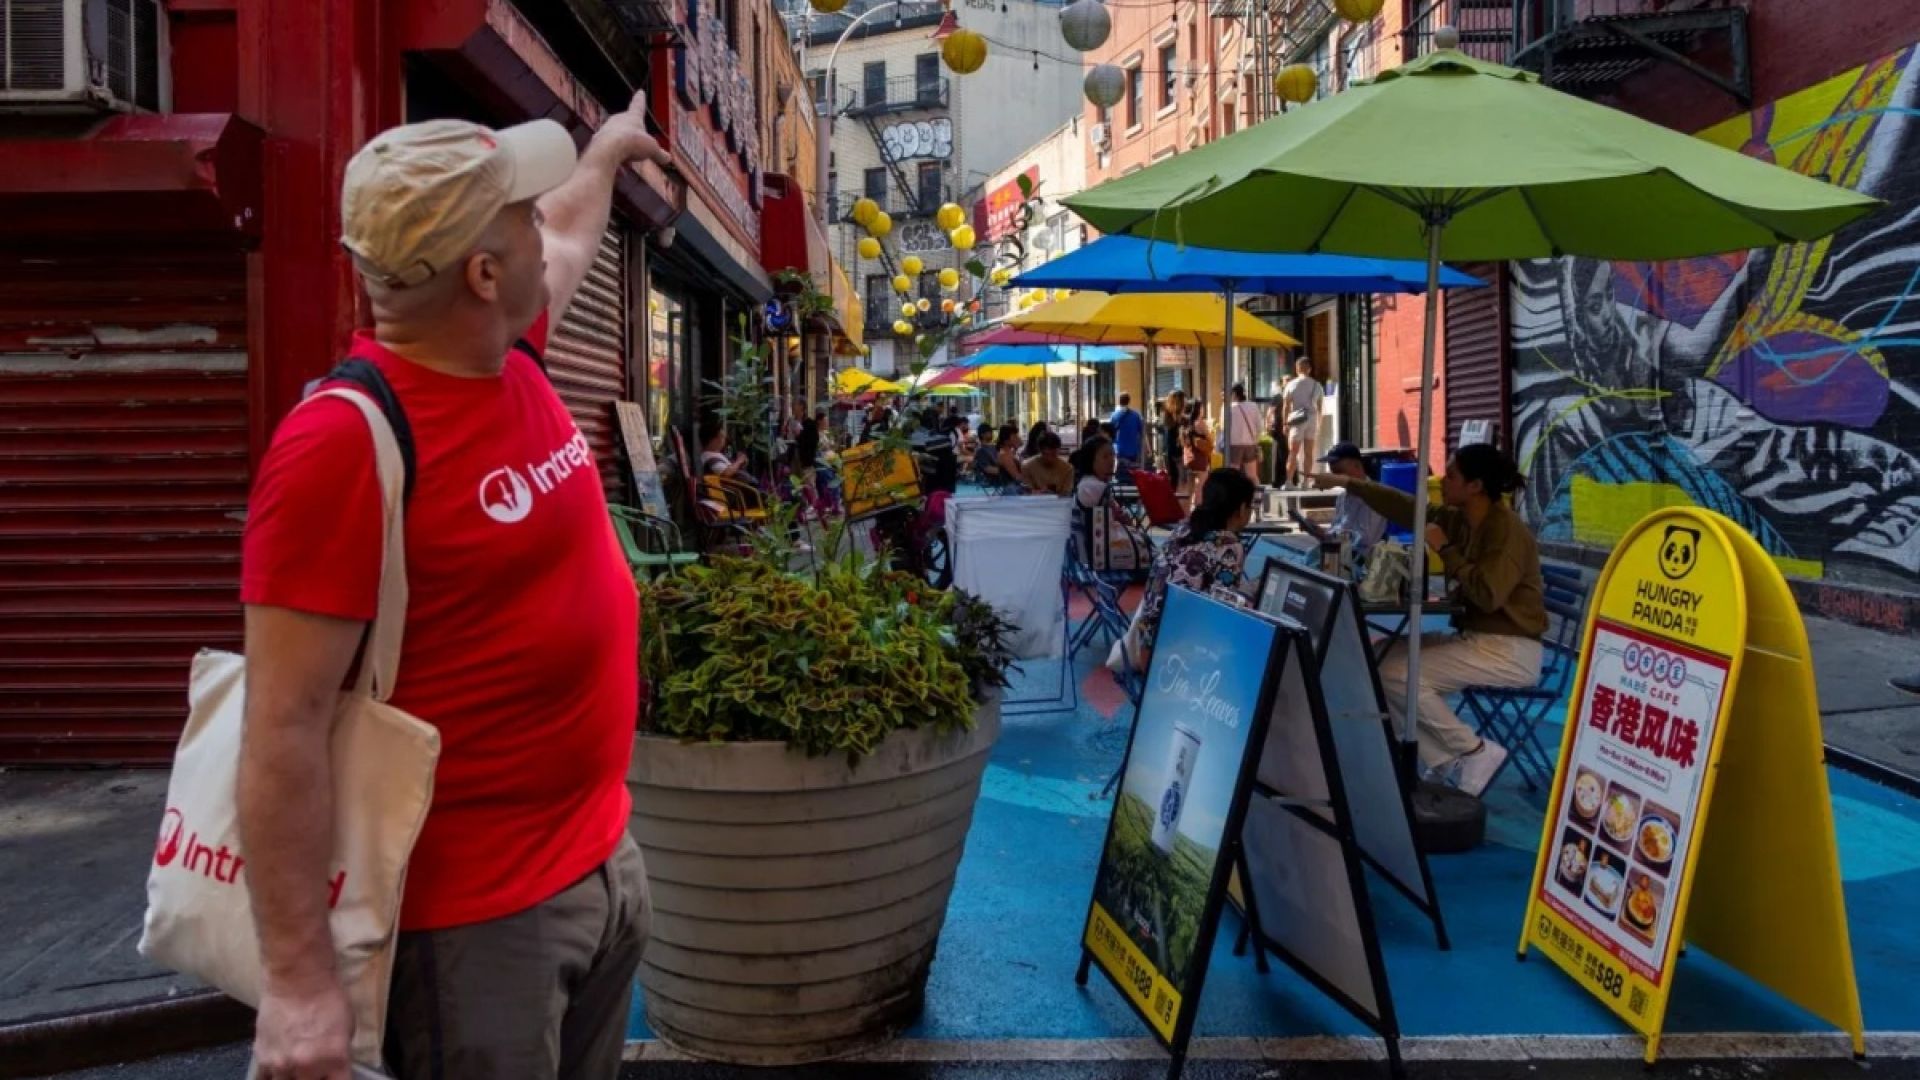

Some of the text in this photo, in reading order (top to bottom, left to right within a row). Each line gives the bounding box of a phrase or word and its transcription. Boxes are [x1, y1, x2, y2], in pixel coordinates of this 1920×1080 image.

[527, 420, 591, 494] Intrep
[1636, 579, 1704, 613] HUNGRY
[1631, 601, 1683, 634] PANDA
[1650, 686, 1680, 706] CAFE
[1589, 683, 1699, 769] 香港风味
[181, 830, 347, 909] Intrd
[1595, 962, 1625, 999] $88
